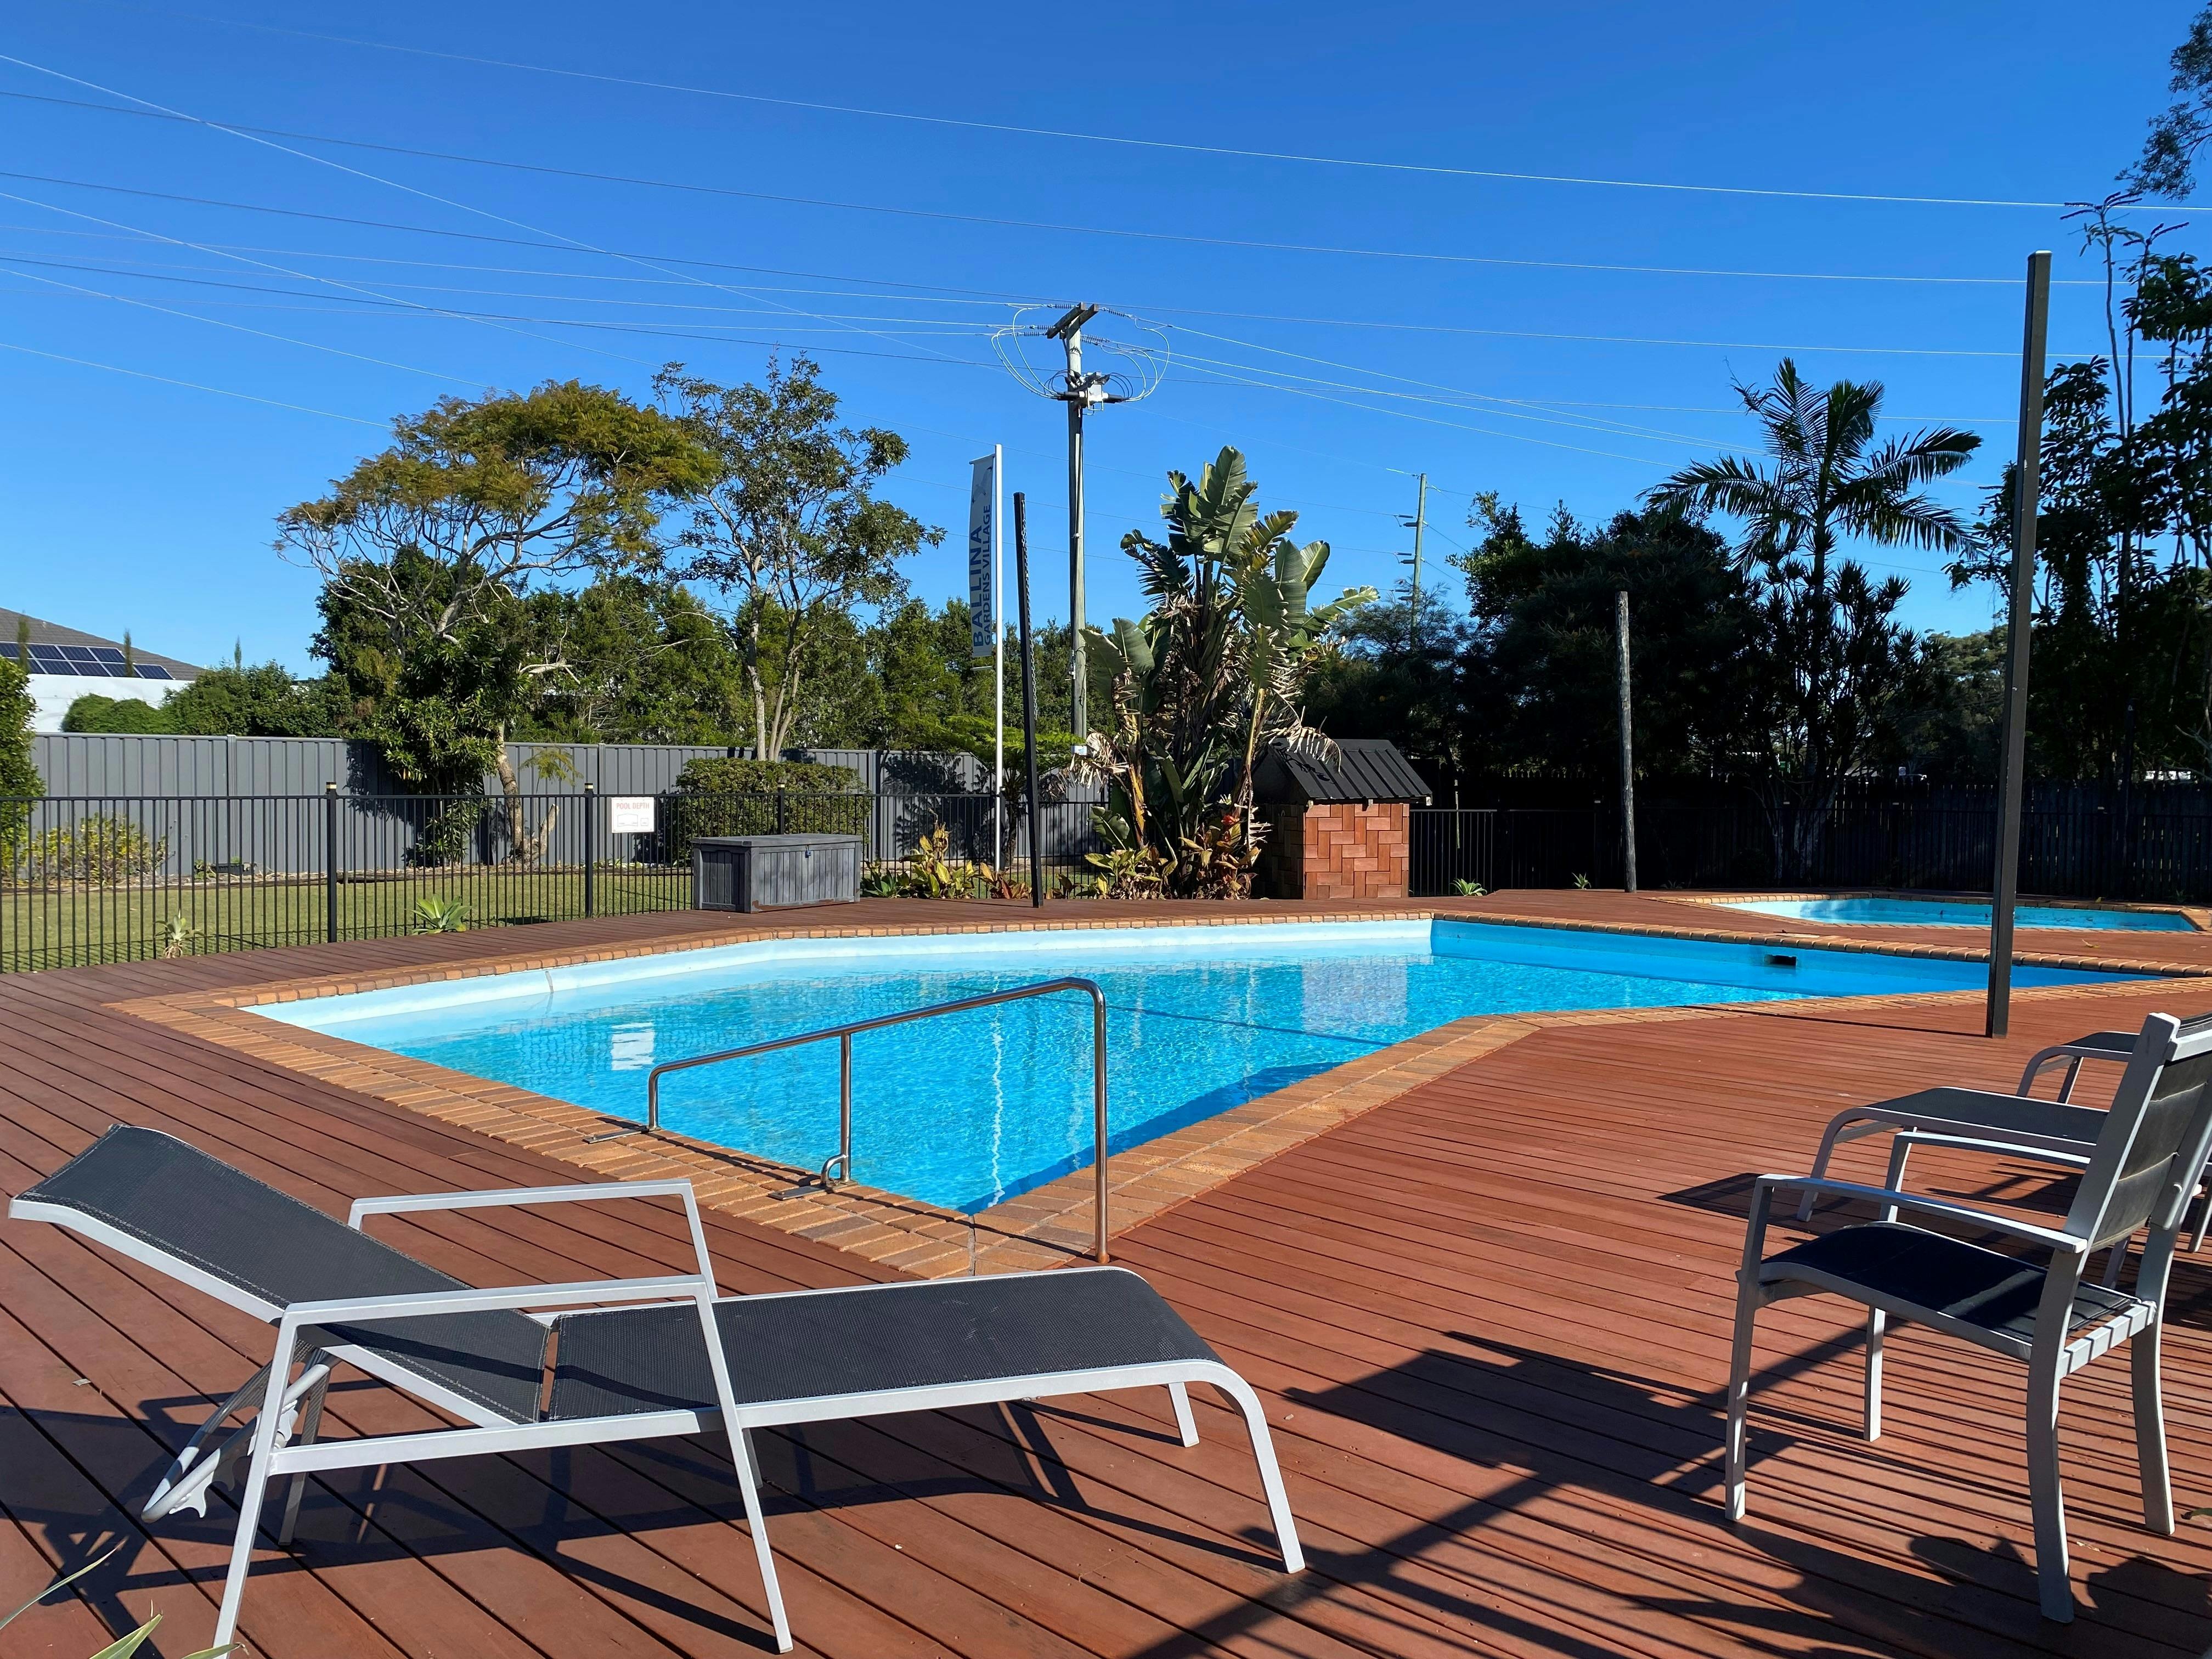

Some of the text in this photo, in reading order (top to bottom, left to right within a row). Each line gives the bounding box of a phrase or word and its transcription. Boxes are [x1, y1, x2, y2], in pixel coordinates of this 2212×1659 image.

[970, 525, 984, 647] BALLINA
[983, 504, 991, 646] GARDENS VILLAGE
